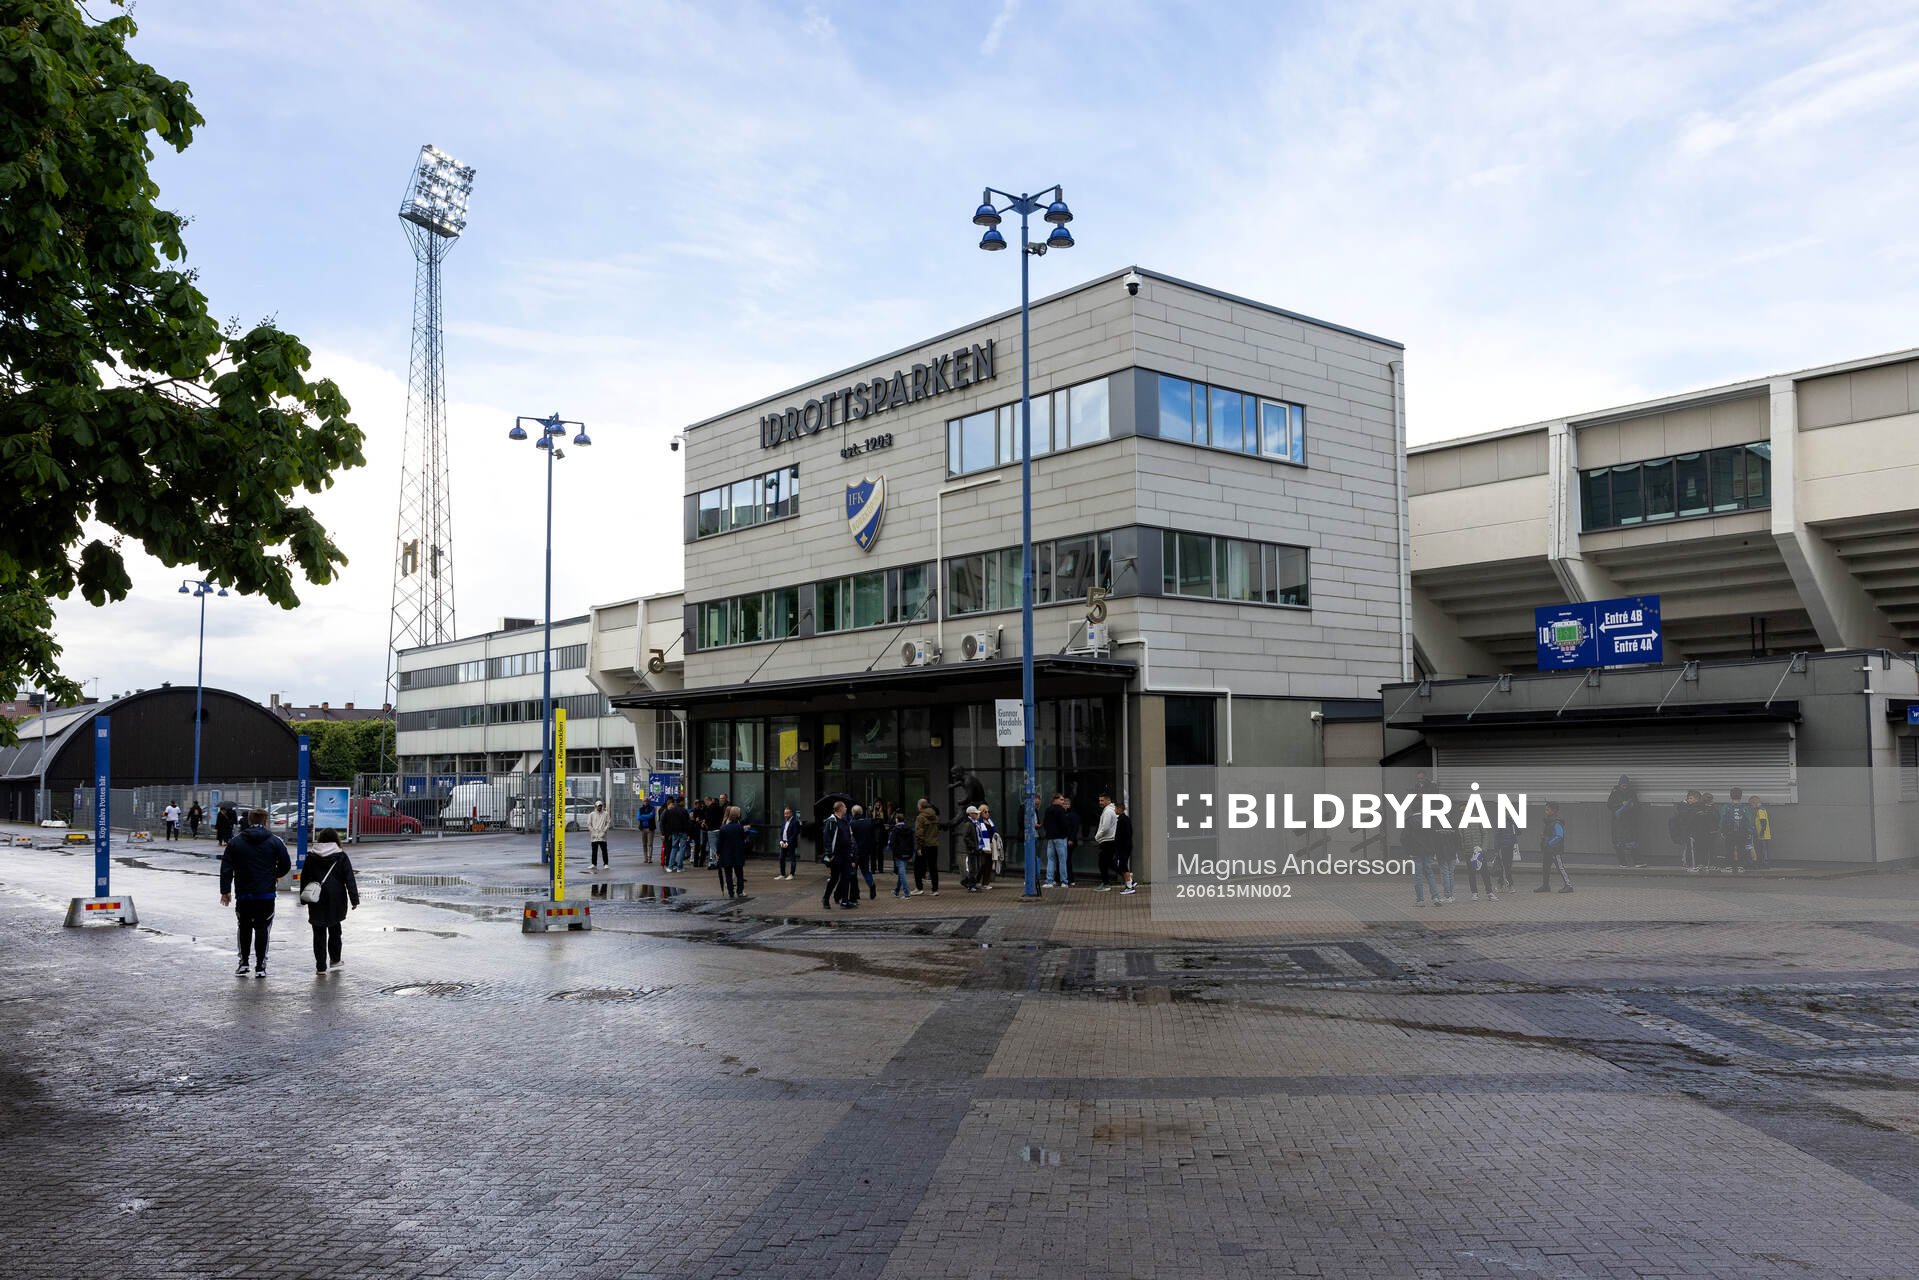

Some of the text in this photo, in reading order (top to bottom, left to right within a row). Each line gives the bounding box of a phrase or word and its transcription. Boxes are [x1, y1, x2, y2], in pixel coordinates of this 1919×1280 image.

[760, 339, 996, 449] IDROTTSPARKEN
[865, 432, 893, 451] 1903
[848, 491, 865, 506] IFK
[1605, 609, 1643, 625] Entré 4B
[1614, 638, 1653, 653] Entré 4A
[998, 709, 1018, 717] Gunnar
[998, 717, 1022, 726] Nordahls
[999, 726, 1011, 736] plats
